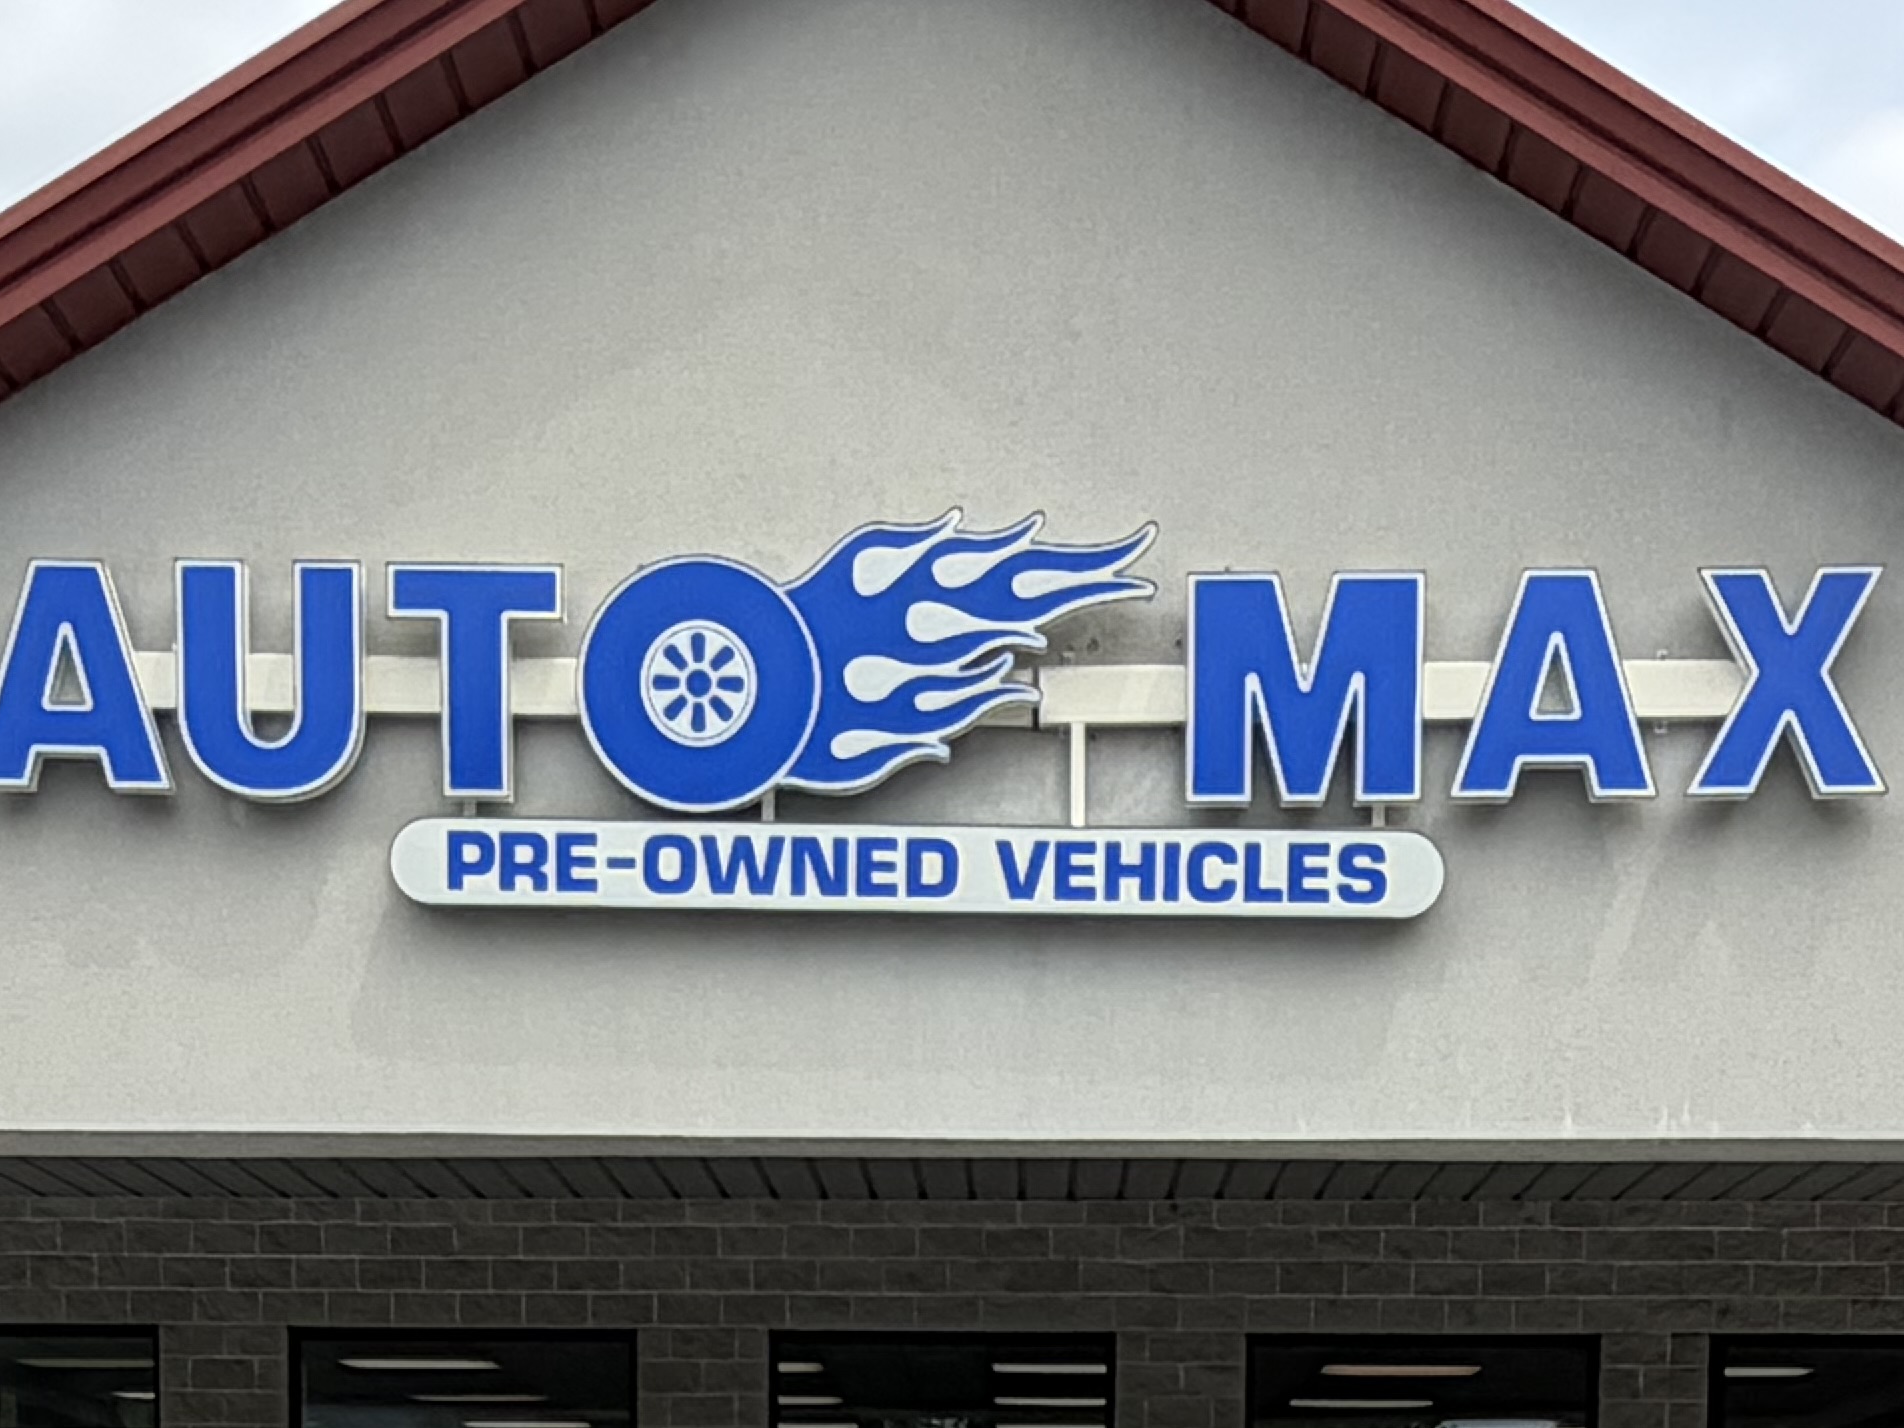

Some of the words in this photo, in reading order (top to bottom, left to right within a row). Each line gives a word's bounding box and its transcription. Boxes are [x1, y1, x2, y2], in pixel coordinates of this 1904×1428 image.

[1185, 566, 1887, 802] MAX
[445, 829, 960, 900] PRE-OWNED
[997, 838, 1389, 905] VEHICLES
